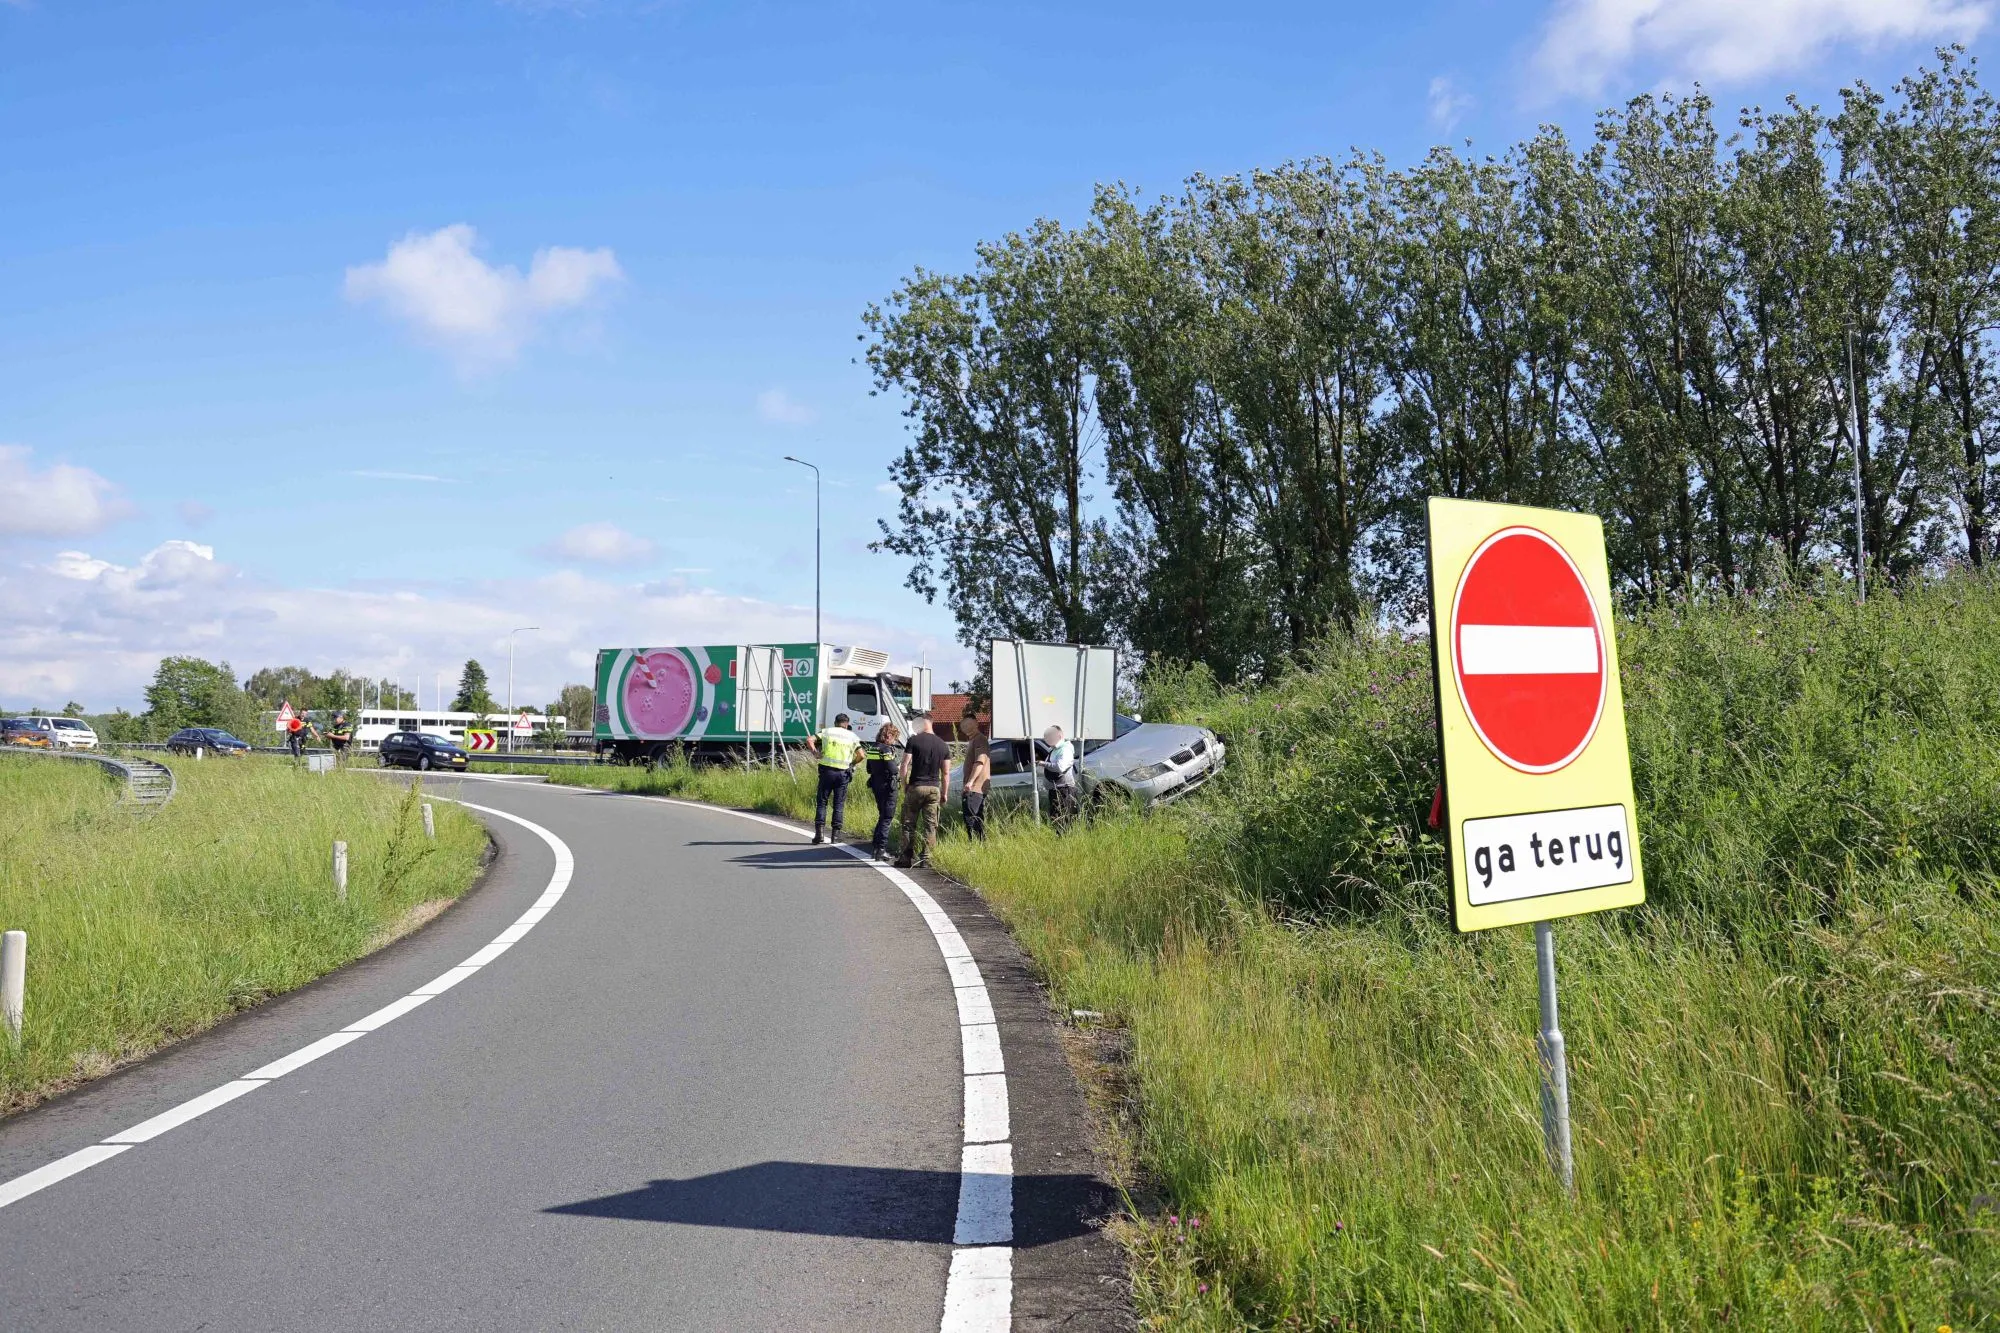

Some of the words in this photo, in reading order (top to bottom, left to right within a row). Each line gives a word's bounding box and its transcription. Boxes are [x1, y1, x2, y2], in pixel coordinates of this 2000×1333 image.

[784, 708, 812, 723] PAR
[1474, 843, 1516, 888] ga
[1530, 830, 1624, 869] terug
